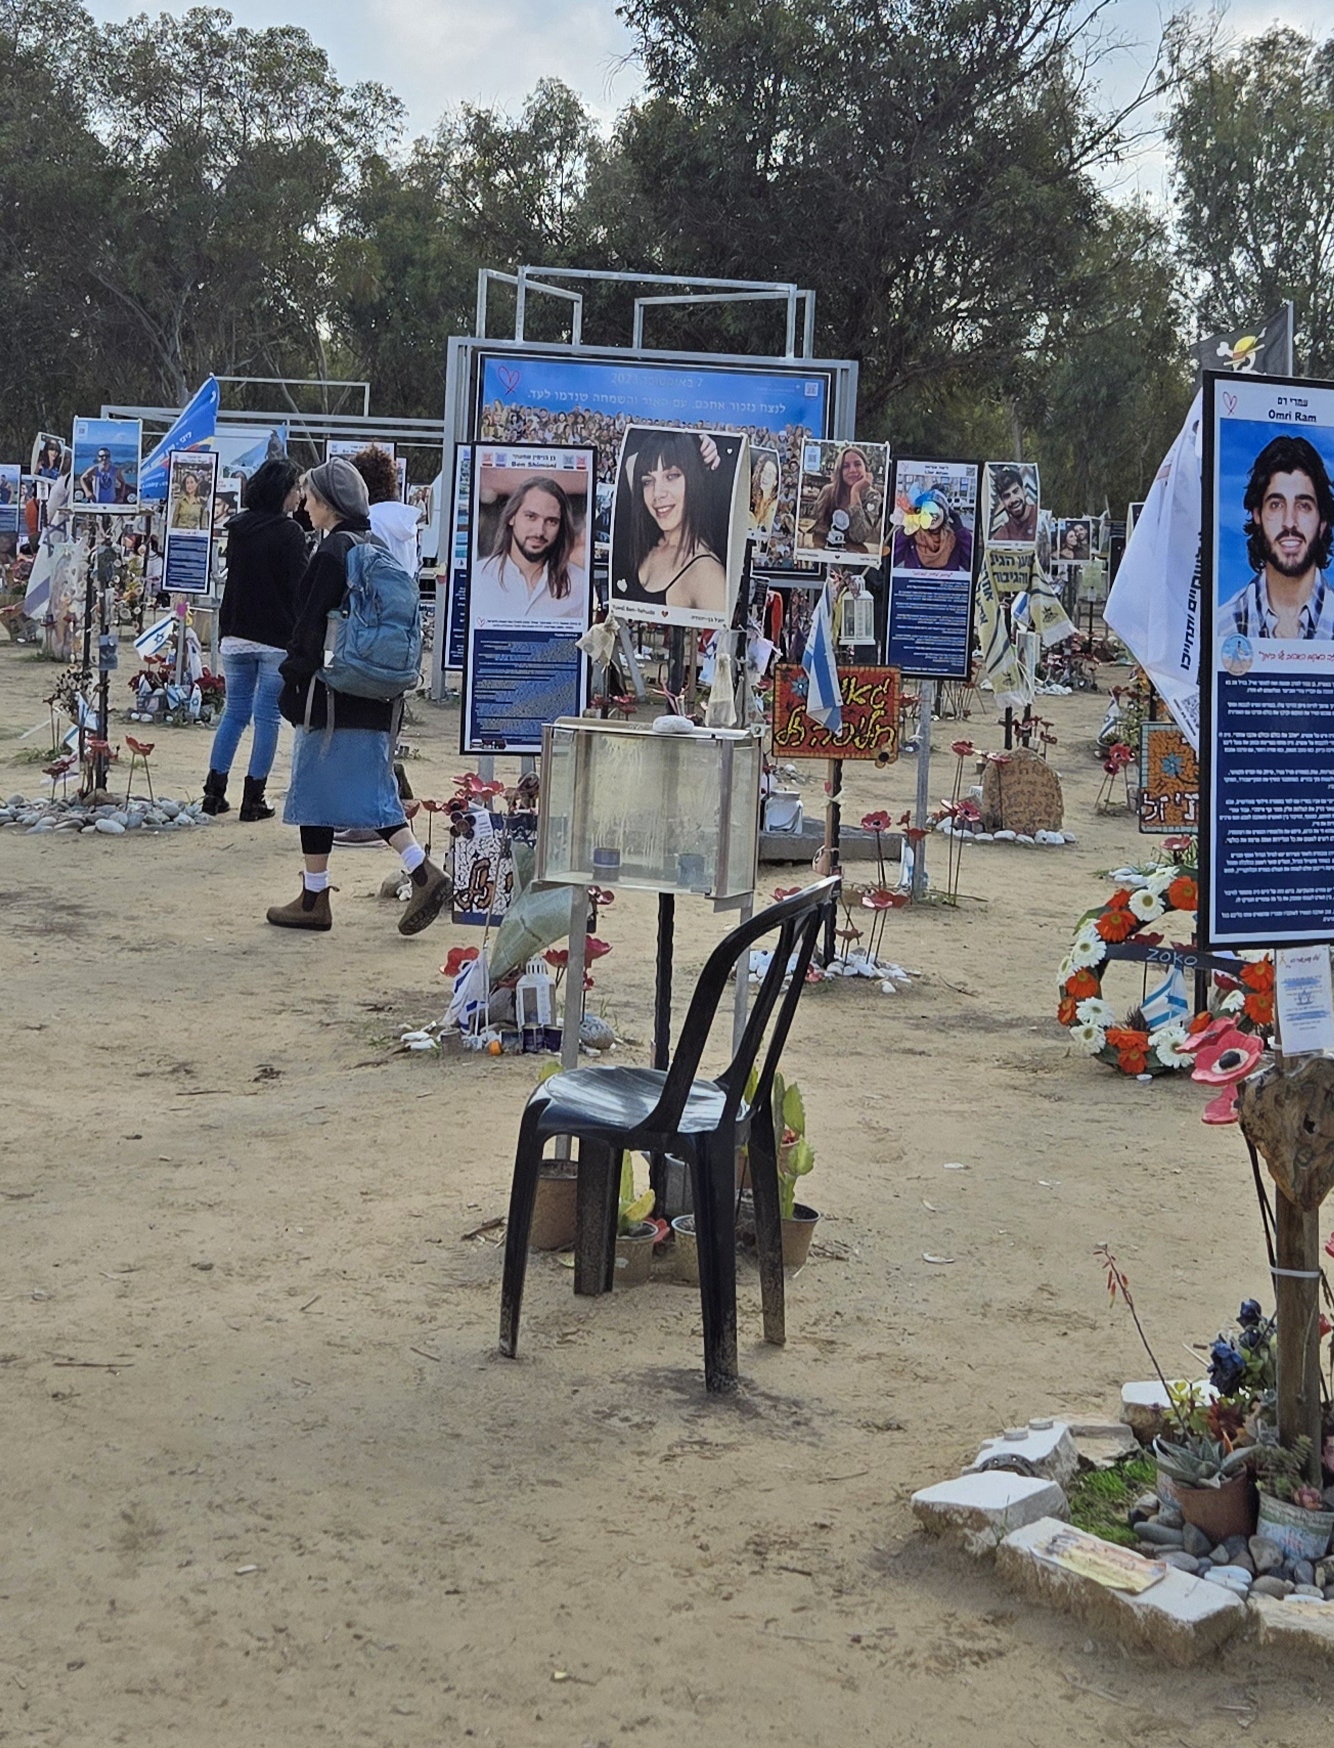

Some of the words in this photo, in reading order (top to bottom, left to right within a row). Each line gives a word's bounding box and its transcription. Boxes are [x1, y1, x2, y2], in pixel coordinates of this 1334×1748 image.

[1277, 397, 1288, 406] רם
[1268, 409, 1292, 421] Omri
[1294, 412, 1317, 423] Ram
[1146, 948, 1198, 966] ZOKO
